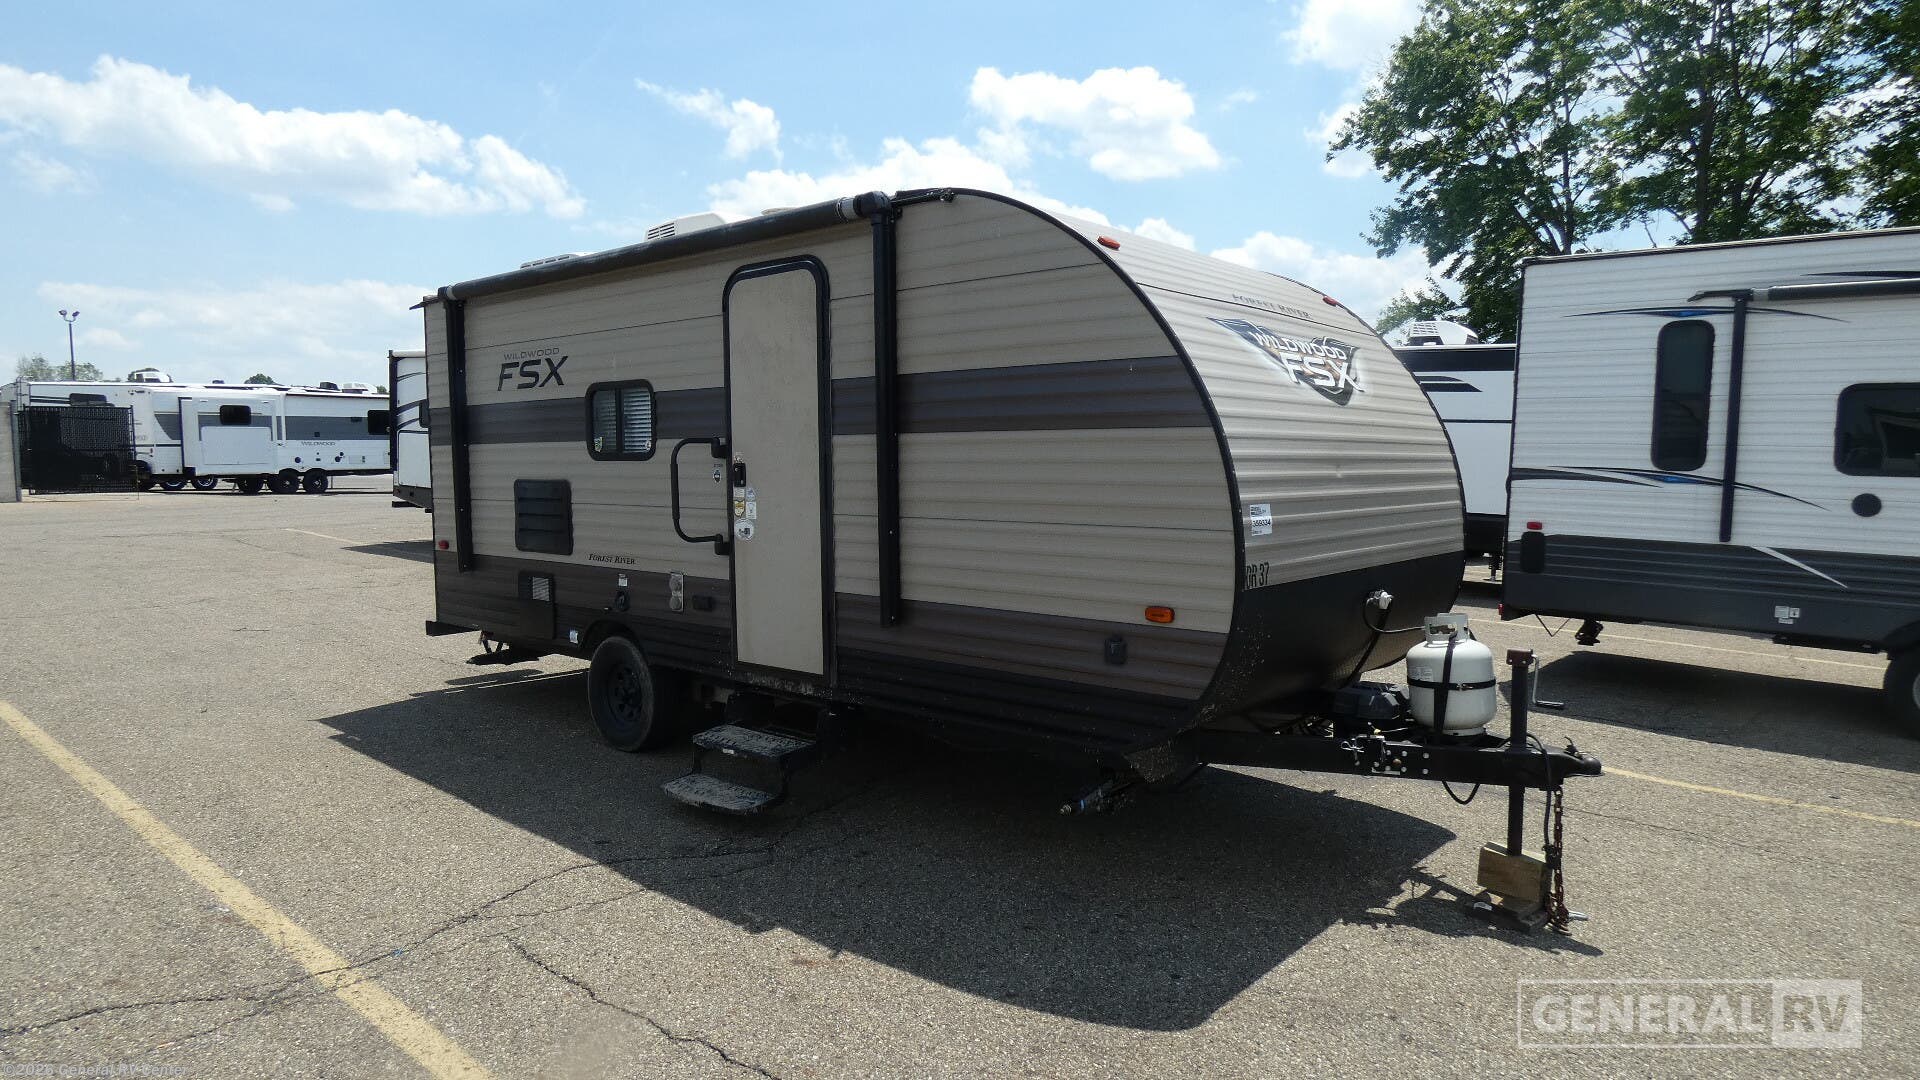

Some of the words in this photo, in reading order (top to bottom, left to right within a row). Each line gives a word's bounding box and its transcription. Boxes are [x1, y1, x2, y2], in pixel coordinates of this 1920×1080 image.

[1277, 303, 1312, 319] RIVER
[503, 347, 560, 361] WILDWOOD
[1249, 331, 1347, 361] WILDWOOD
[497, 355, 569, 391] FSX
[1279, 351, 1366, 393] FSX
